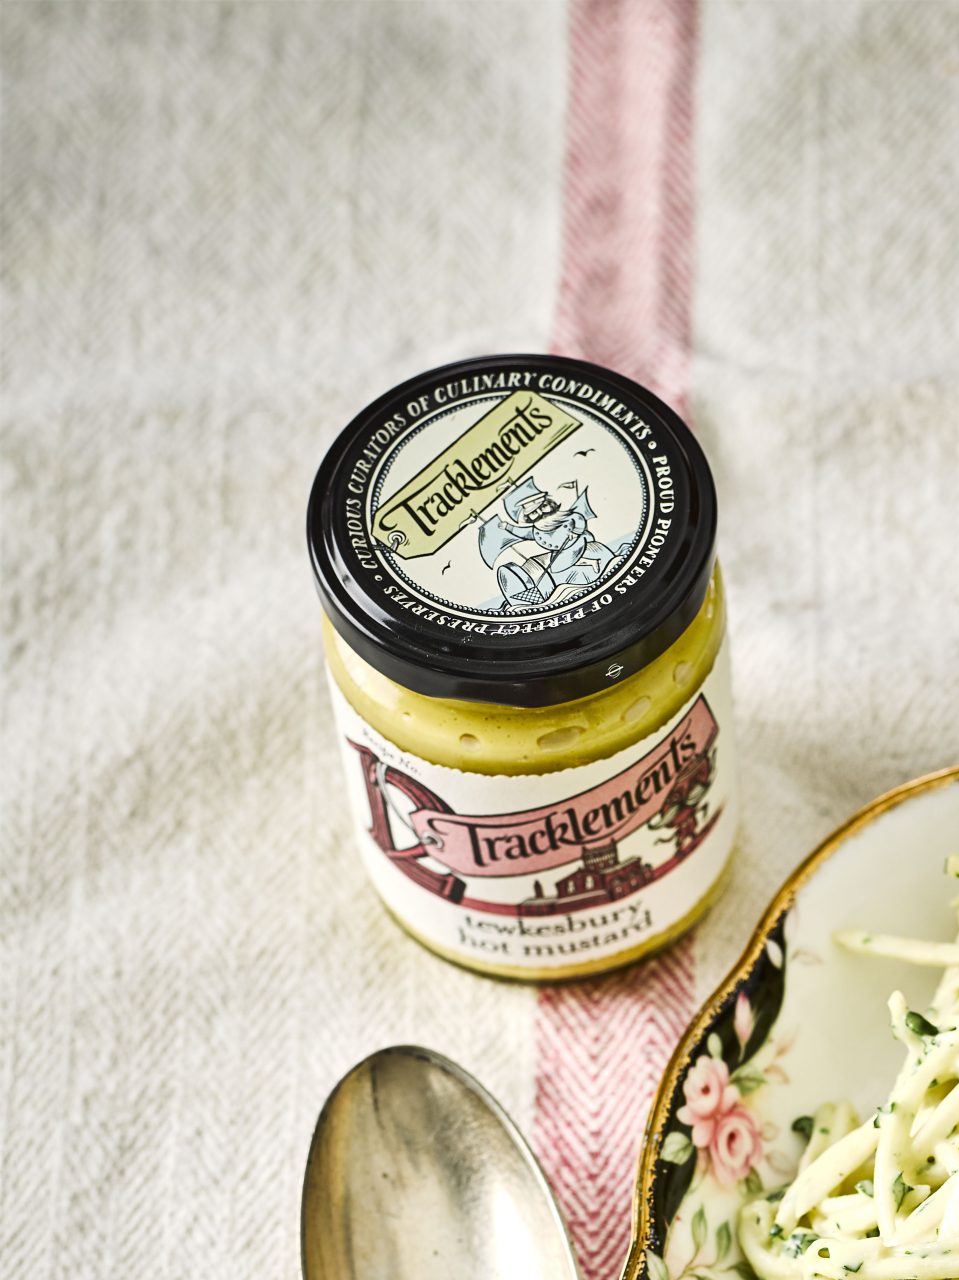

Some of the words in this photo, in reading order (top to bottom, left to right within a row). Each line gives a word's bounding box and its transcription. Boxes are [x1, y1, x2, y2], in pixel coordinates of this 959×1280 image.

[406, 396, 430, 417] OF
[434, 372, 537, 403] CULINARY
[539, 374, 652, 441] CONDIMENTS
[347, 413, 407, 494] CURATORS
[378, 396, 553, 537] Tracklements
[652, 455, 675, 514] PROUD
[346, 498, 378, 570] CURIOUS
[614, 518, 672, 595] PIONEERS
[384, 585, 487, 634] PRESERVES
[491, 611, 587, 635] PERFECT
[591, 593, 613, 612] OF
[427, 718, 696, 867] Tracklements
[458, 925, 512, 955] hot
[523, 909, 654, 957] mustard
[465, 900, 643, 937] tewkesbury
